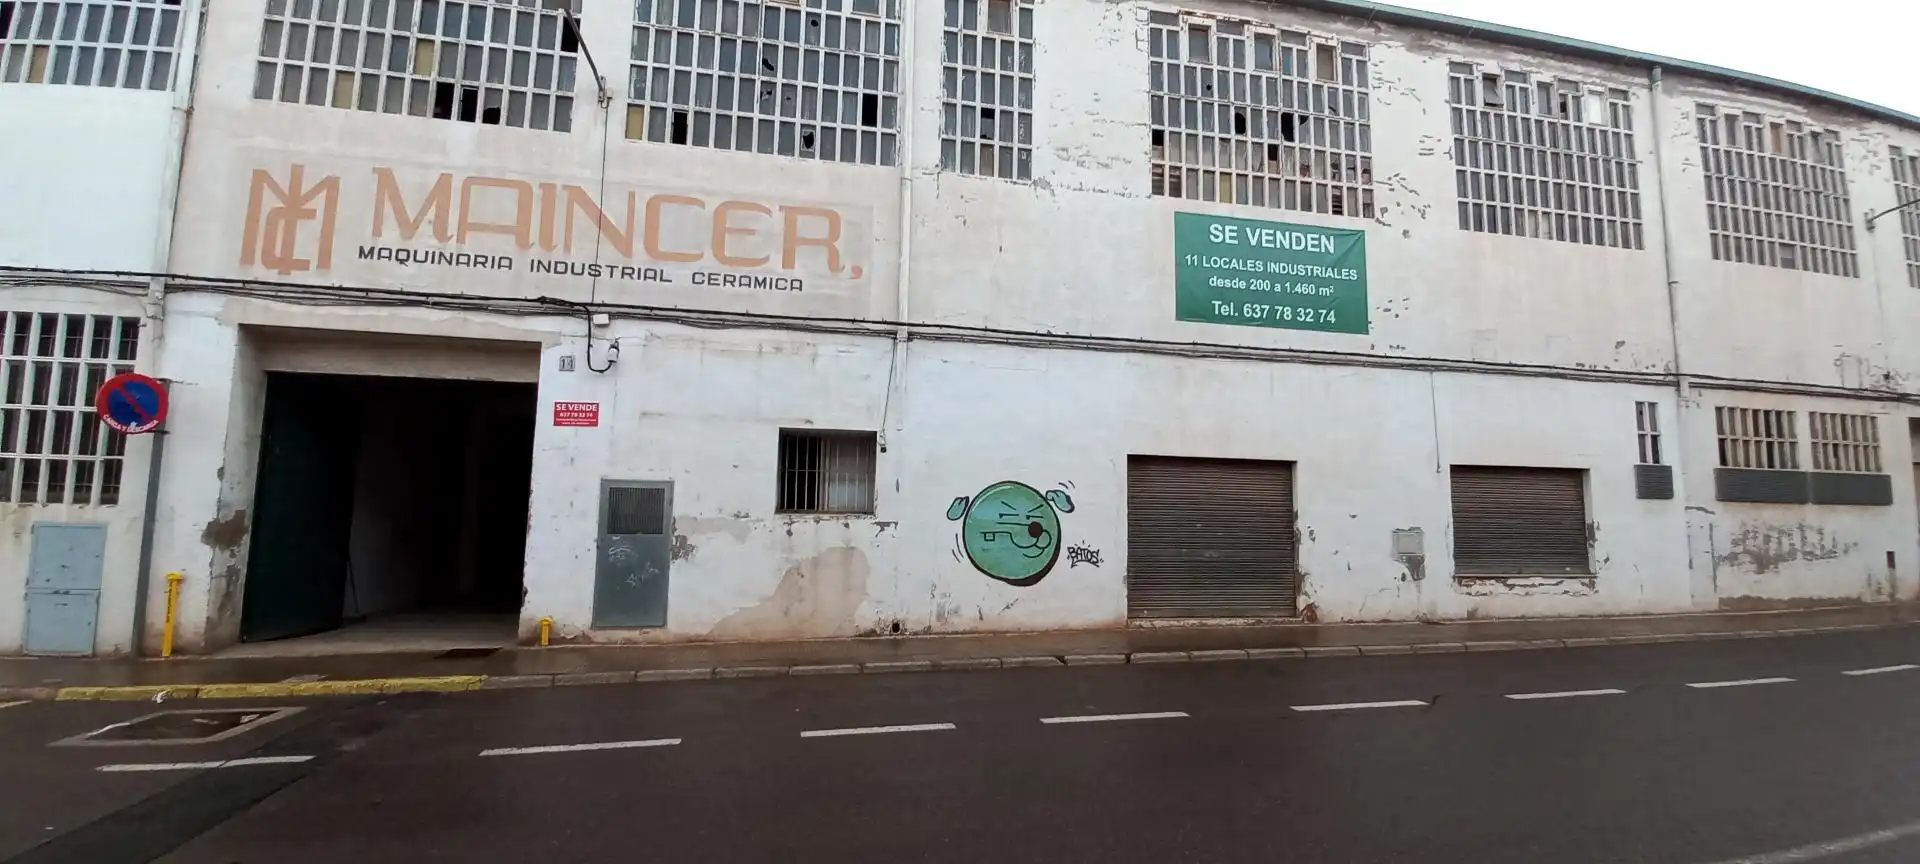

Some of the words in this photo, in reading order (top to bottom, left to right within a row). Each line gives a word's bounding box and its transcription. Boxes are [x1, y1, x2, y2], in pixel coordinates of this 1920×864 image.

[1209, 223, 1238, 245] SE
[1245, 227, 1335, 254] VENDEN
[358, 246, 514, 271] MAQUINARIA
[529, 258, 673, 284] INDUSTRIAL
[691, 271, 804, 292] CERAMICA
[1184, 254, 1198, 267] 11
[1202, 255, 1264, 273] LOCALES
[1267, 261, 1358, 281] INDUSTRIALES
[1208, 276, 1246, 289] desde
[1249, 279, 1271, 292] 200
[1274, 283, 1282, 293] a
[1284, 281, 1316, 295] 1.460
[1211, 301, 1239, 316] Tel.
[1243, 303, 1270, 319] 637
[1274, 306, 1292, 321] 78
[1296, 308, 1314, 322] 32
[1318, 309, 1337, 324] 74
